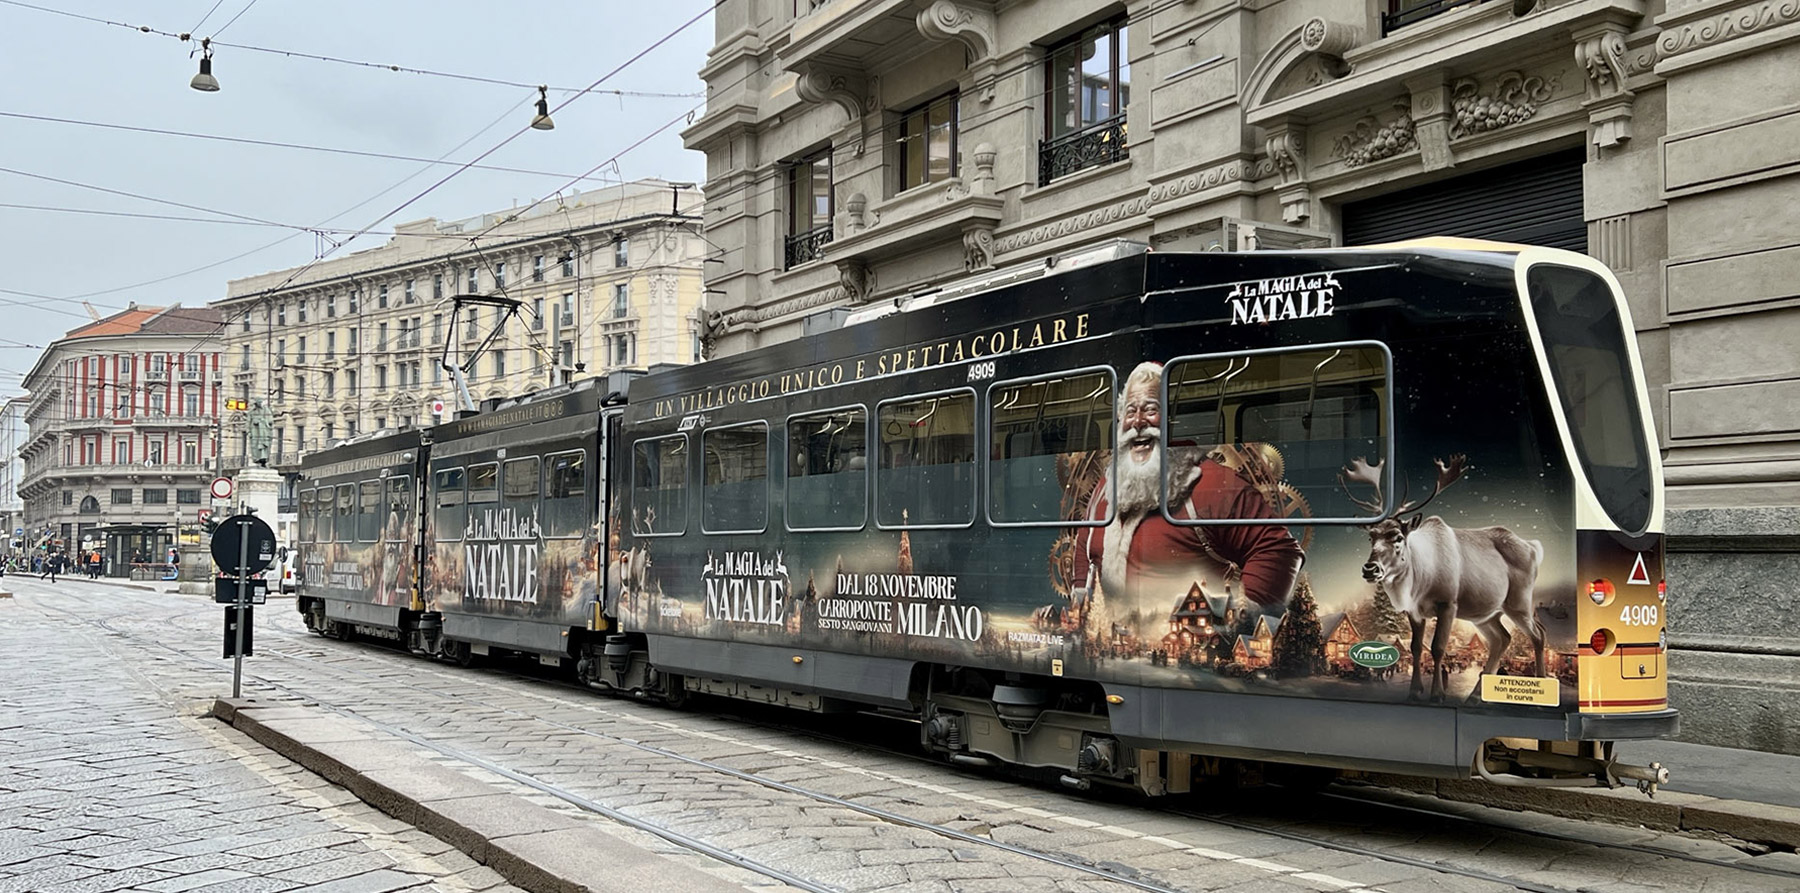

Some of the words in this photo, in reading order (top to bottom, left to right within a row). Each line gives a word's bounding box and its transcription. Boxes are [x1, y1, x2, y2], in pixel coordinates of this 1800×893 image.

[1244, 286, 1256, 297] La
[1258, 275, 1307, 296] MAGIA
[1307, 278, 1322, 290] del
[1230, 287, 1335, 326] NATALE
[655, 399, 674, 417] UN
[681, 379, 769, 413] VILLAGGIO
[780, 364, 843, 394] UNICO
[856, 360, 865, 380] E
[877, 313, 1089, 376] SPETTACOLARE
[968, 362, 995, 381] 4909
[475, 519, 483, 538] La
[484, 507, 518, 539] MAGIA
[519, 516, 530, 538] del
[465, 543, 538, 605] NATALE
[715, 559, 724, 576] La
[725, 551, 761, 576] MAGIA
[763, 559, 774, 576] del
[837, 573, 863, 595] DAL
[864, 573, 878, 596] 18
[879, 574, 957, 600] NOVEMBRE
[705, 578, 784, 626] NATALE
[818, 598, 892, 621] CARROPONTE
[897, 602, 983, 641] MILANO
[818, 619, 841, 629] SESTO
[1620, 605, 1658, 626] 4909
[1047, 635, 1064, 645] LIVE
[1353, 650, 1393, 660] VIRIDEA
[1499, 679, 1541, 687] ATTENZIONE
[1509, 687, 1545, 695] accostarsi
